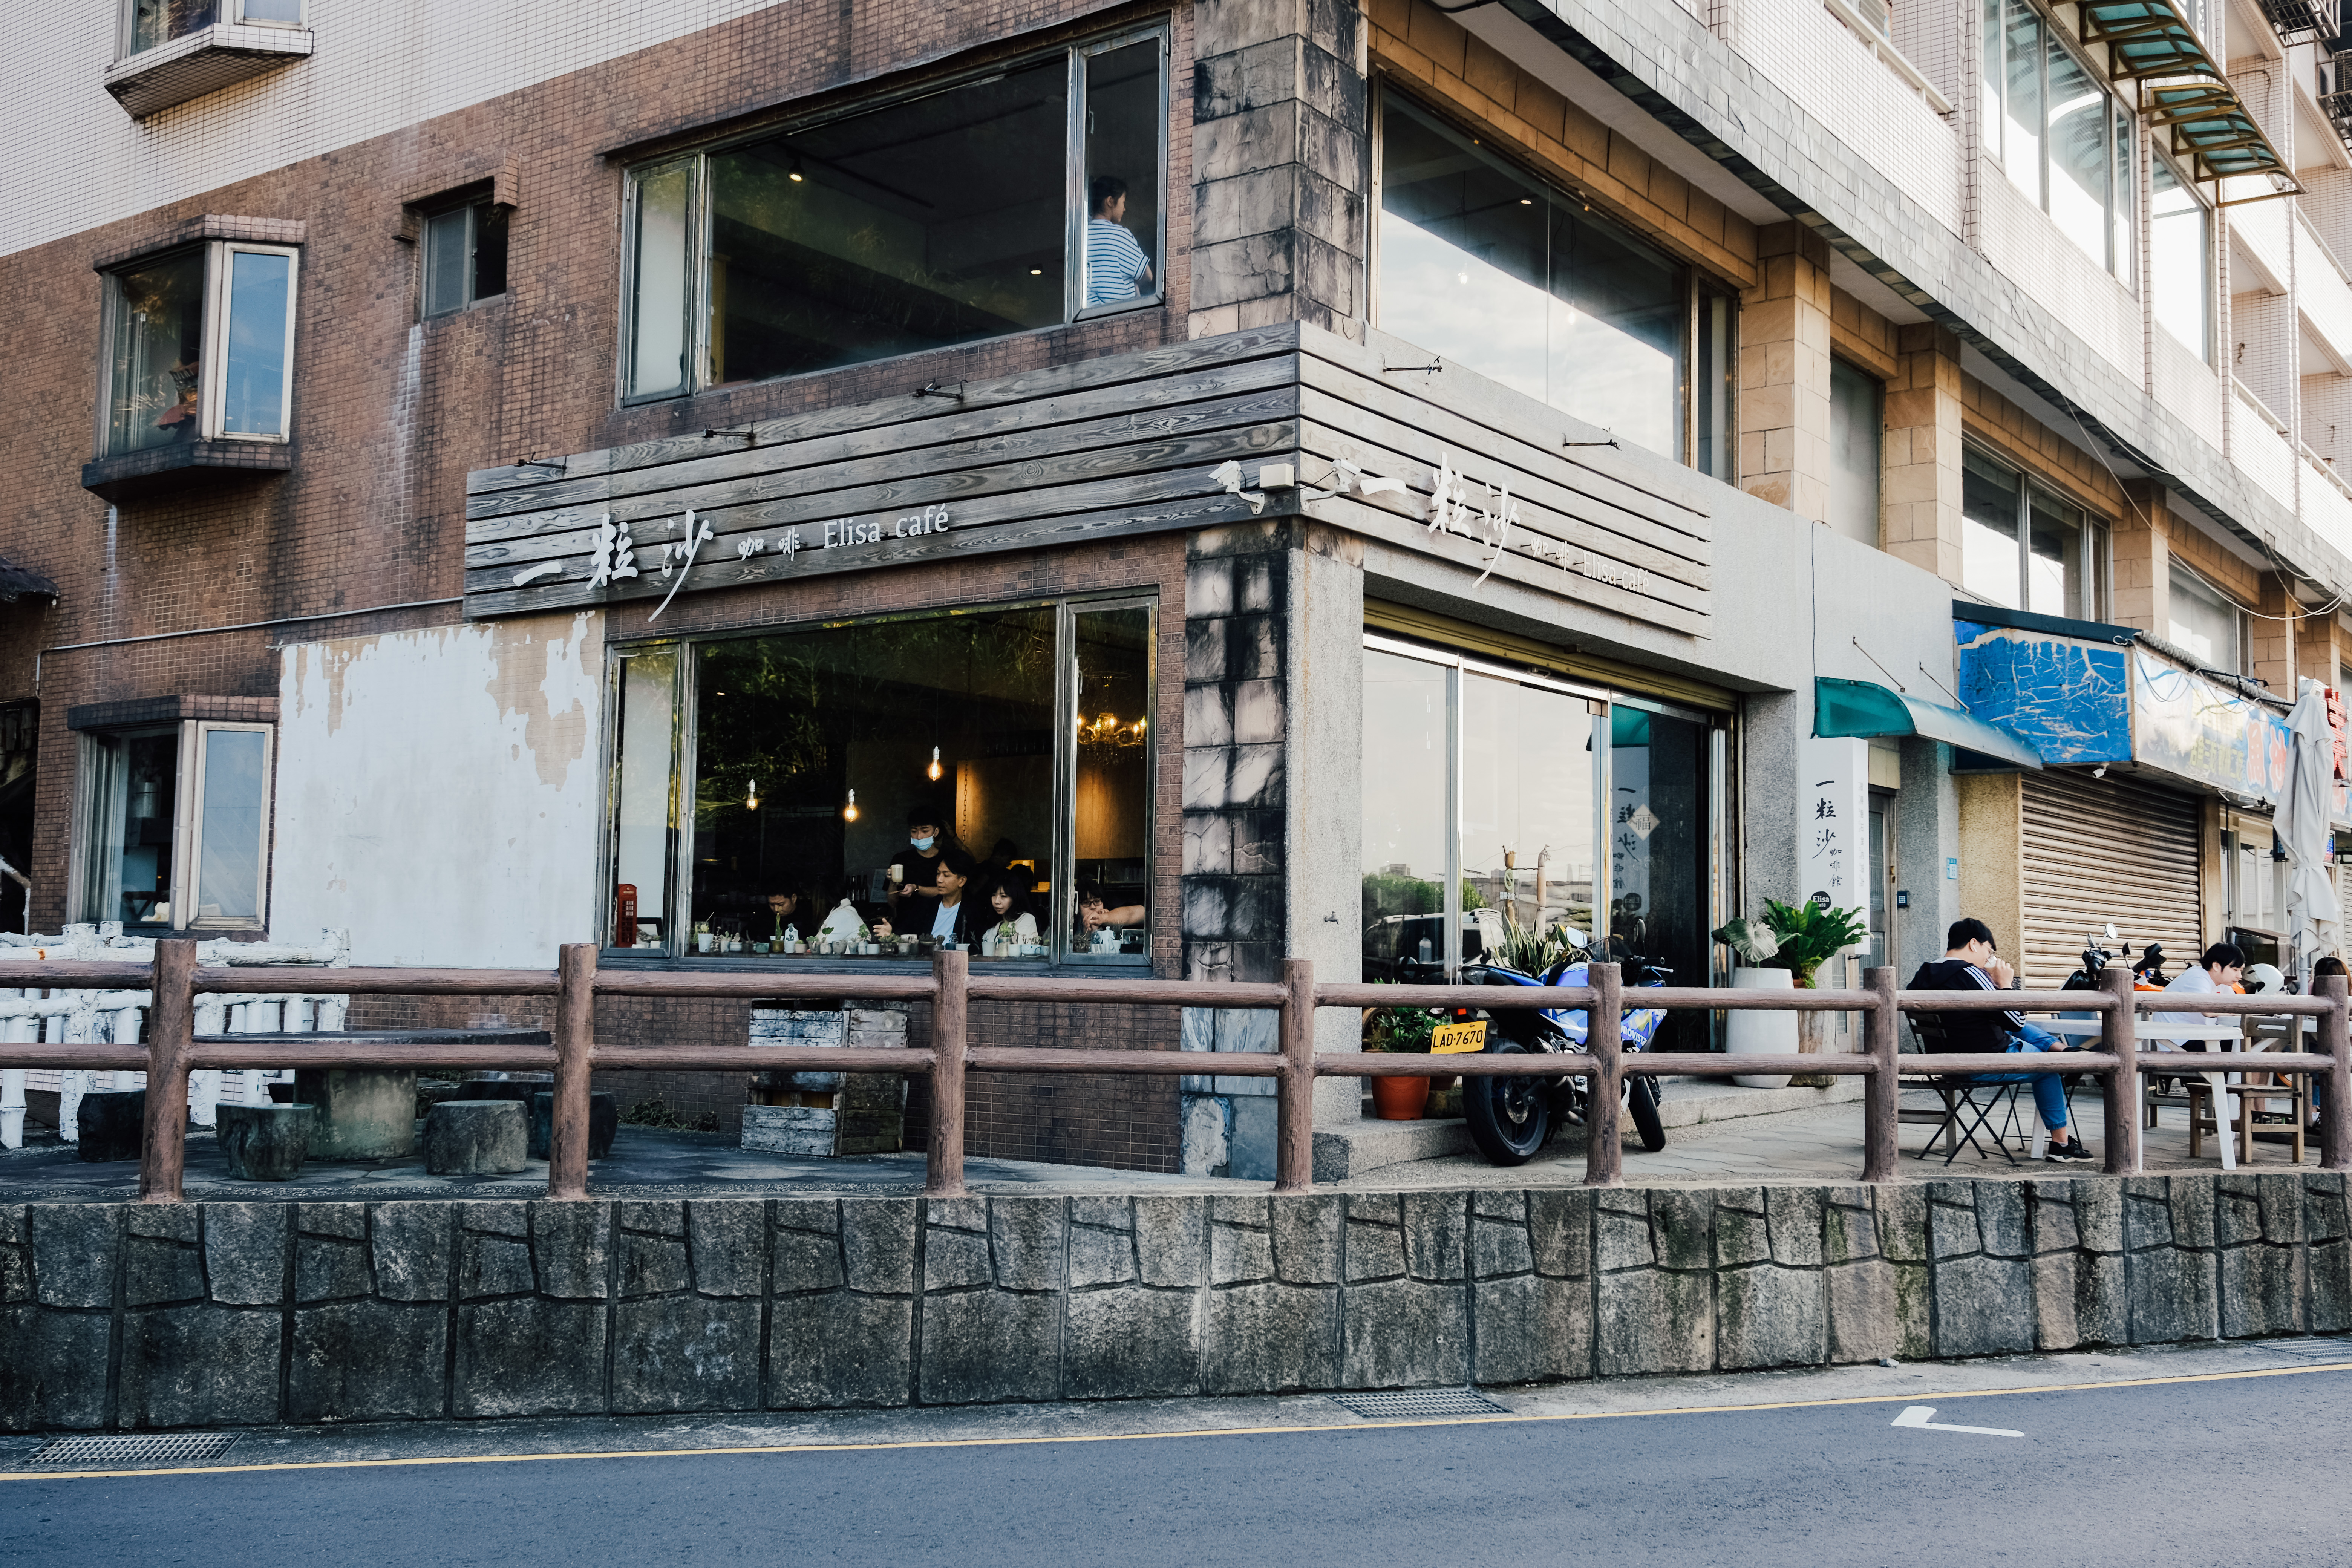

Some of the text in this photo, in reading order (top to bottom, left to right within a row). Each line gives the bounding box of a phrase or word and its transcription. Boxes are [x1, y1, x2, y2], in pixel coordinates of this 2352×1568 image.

[513, 502, 949, 622] 一粒沙 咖啡 Elisa café
[1360, 451, 1649, 595] 一粒沙 咖啡 Elisa café
[1636, 814, 1651, 830] 福
[1812, 780, 1836, 859] 一粒沙
[1827, 848, 1842, 888] 咖啡館
